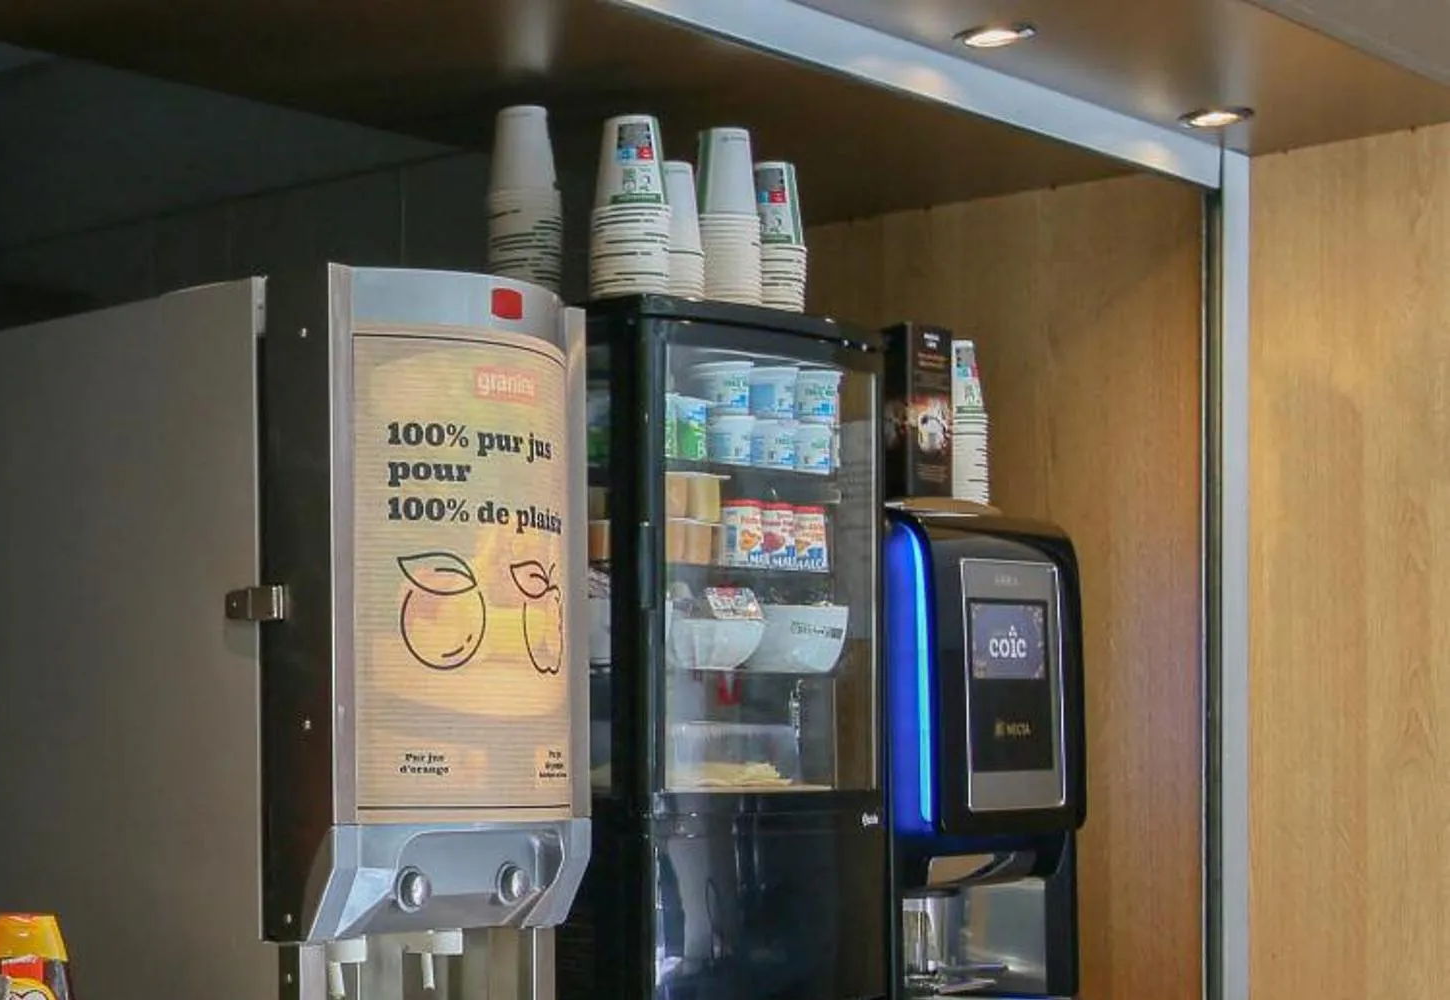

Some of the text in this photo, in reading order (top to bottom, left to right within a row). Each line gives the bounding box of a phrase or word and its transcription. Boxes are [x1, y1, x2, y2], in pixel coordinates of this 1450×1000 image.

[387, 421, 552, 463] 100% pur jus
[387, 461, 472, 487] pour
[387, 496, 469, 523] 100%
[477, 501, 510, 525] de
